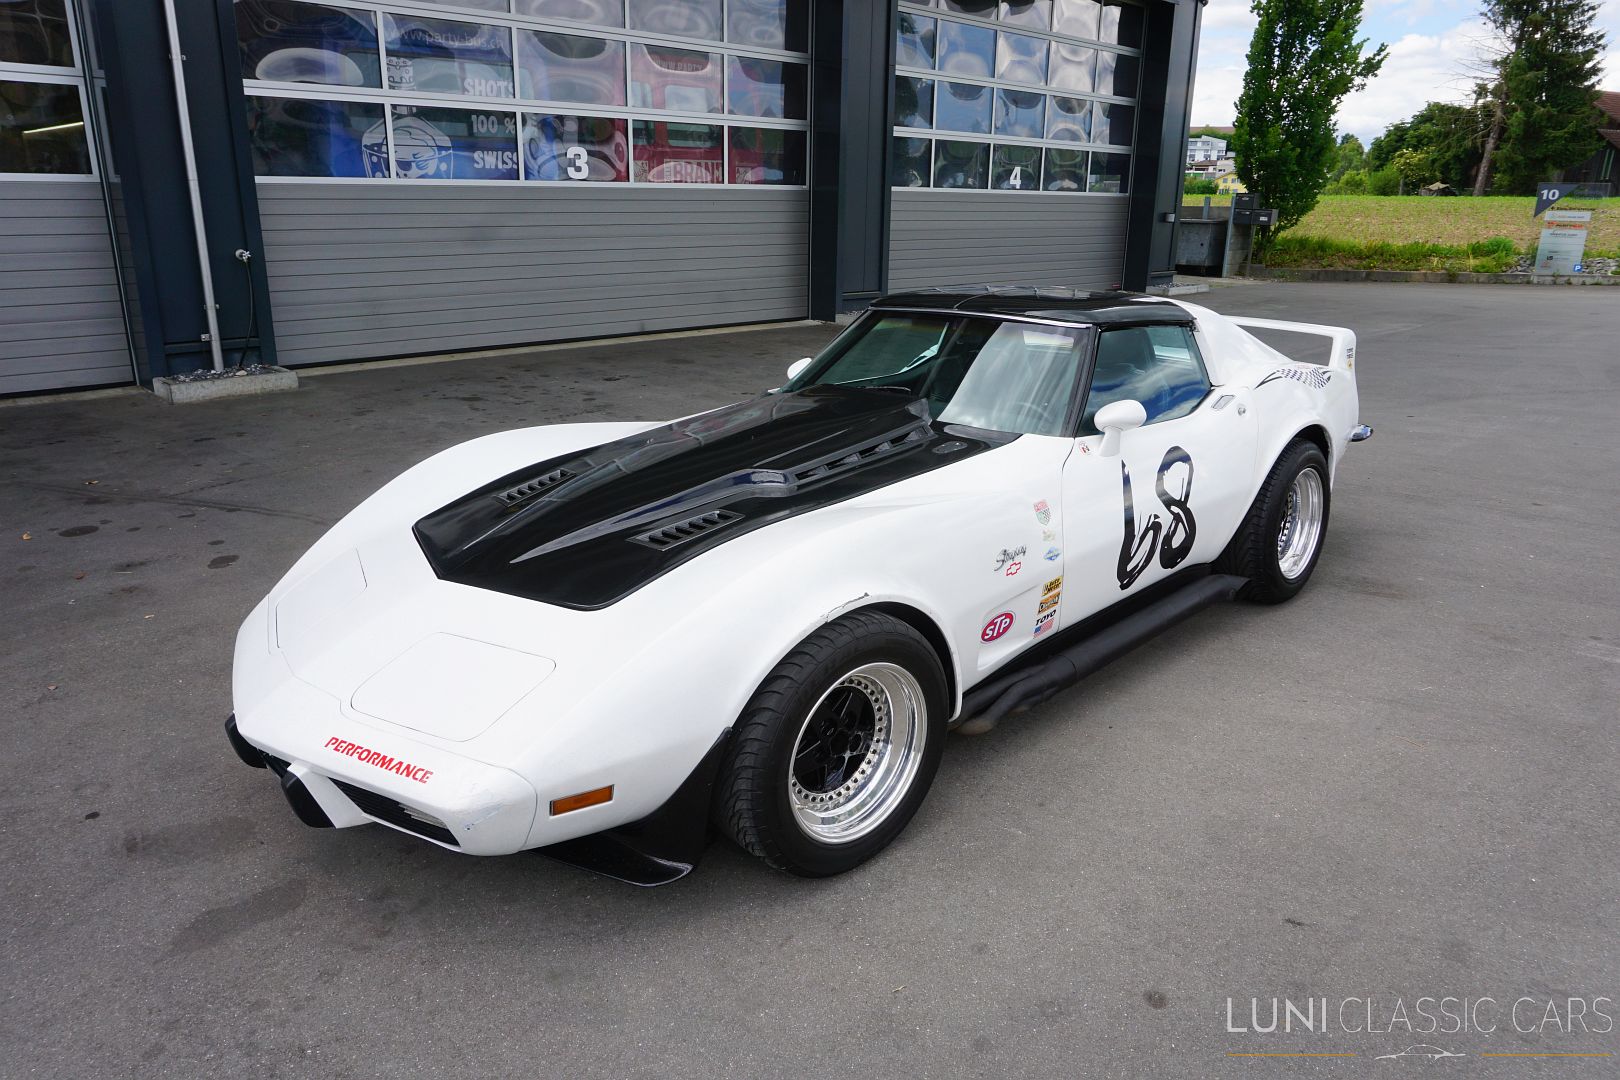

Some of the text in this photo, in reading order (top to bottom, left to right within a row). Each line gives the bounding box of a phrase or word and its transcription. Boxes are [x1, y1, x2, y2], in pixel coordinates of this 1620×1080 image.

[463, 79, 514, 98] SHOTS
[471, 114, 498, 133] 100
[566, 146, 590, 180] 3
[1010, 167, 1021, 189] 4
[1540, 189, 1560, 201] 10
[1116, 445, 1197, 591] 68
[983, 614, 1011, 640] STP
[1035, 608, 1057, 627] TOYO
[324, 737, 434, 783] PERFORMANCE
